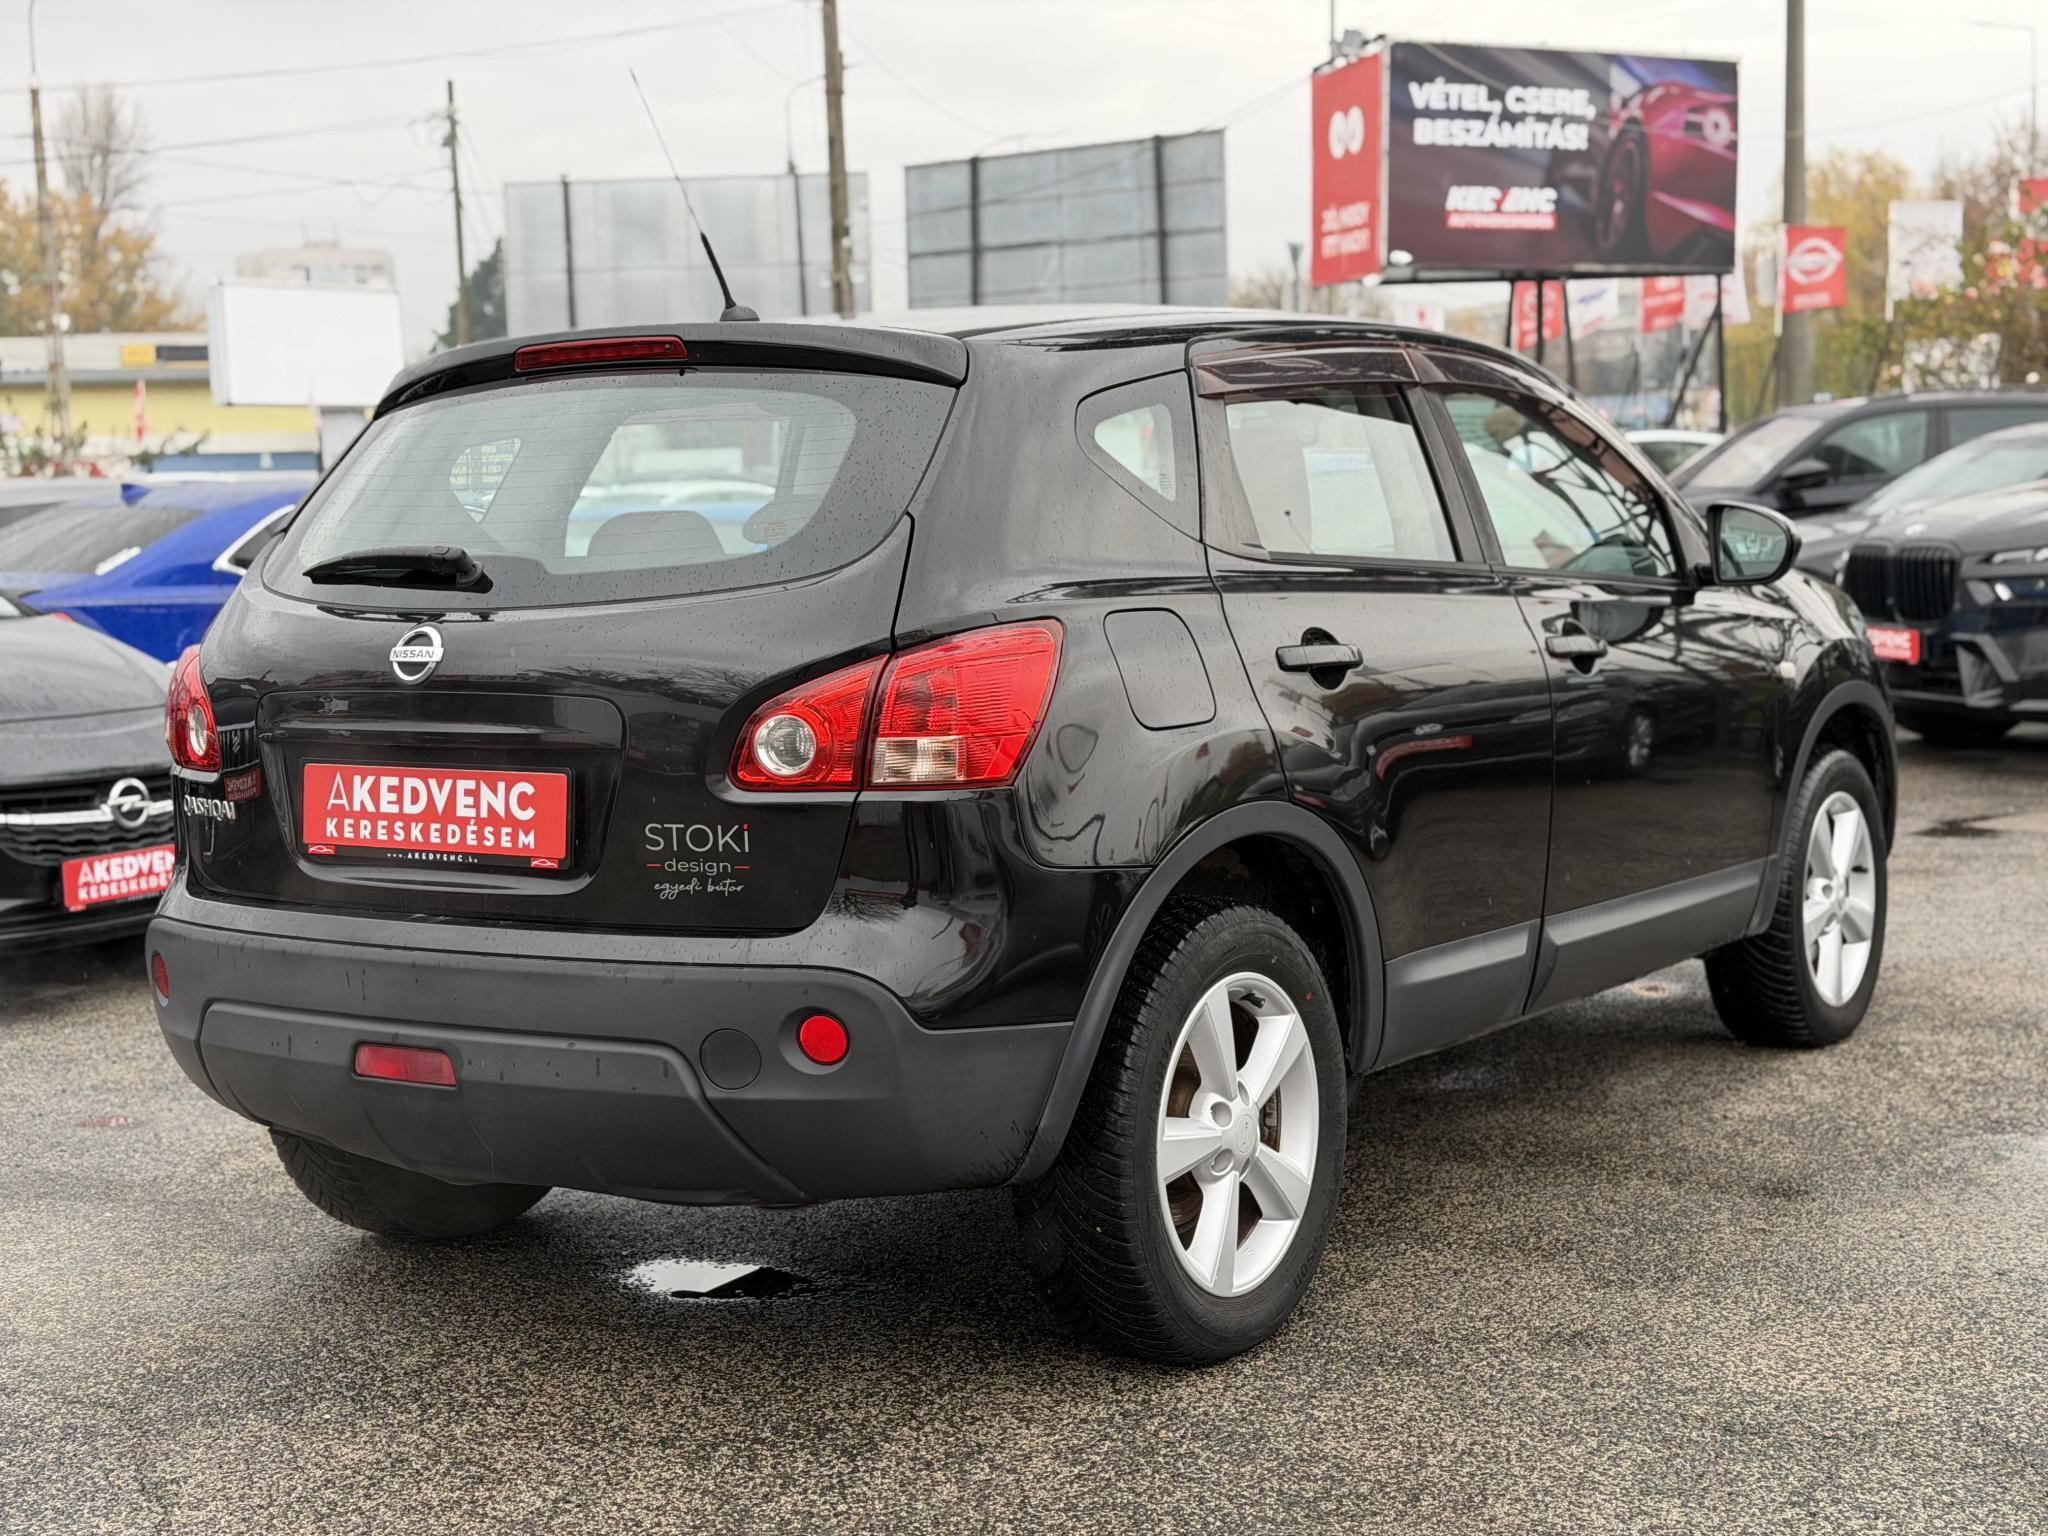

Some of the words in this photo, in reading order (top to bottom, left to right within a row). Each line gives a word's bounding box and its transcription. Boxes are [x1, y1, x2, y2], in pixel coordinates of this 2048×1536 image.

[1408, 76, 1502, 115] VÉTEL,
[1505, 86, 1597, 121] CSERE,
[1413, 113, 1589, 150] BESZÁMÍTÁS!
[392, 649, 435, 659] NISSAN
[325, 816, 536, 850] KERESKEDÉSEM
[664, 857, 732, 876] design
[653, 877, 703, 900] egyedi
